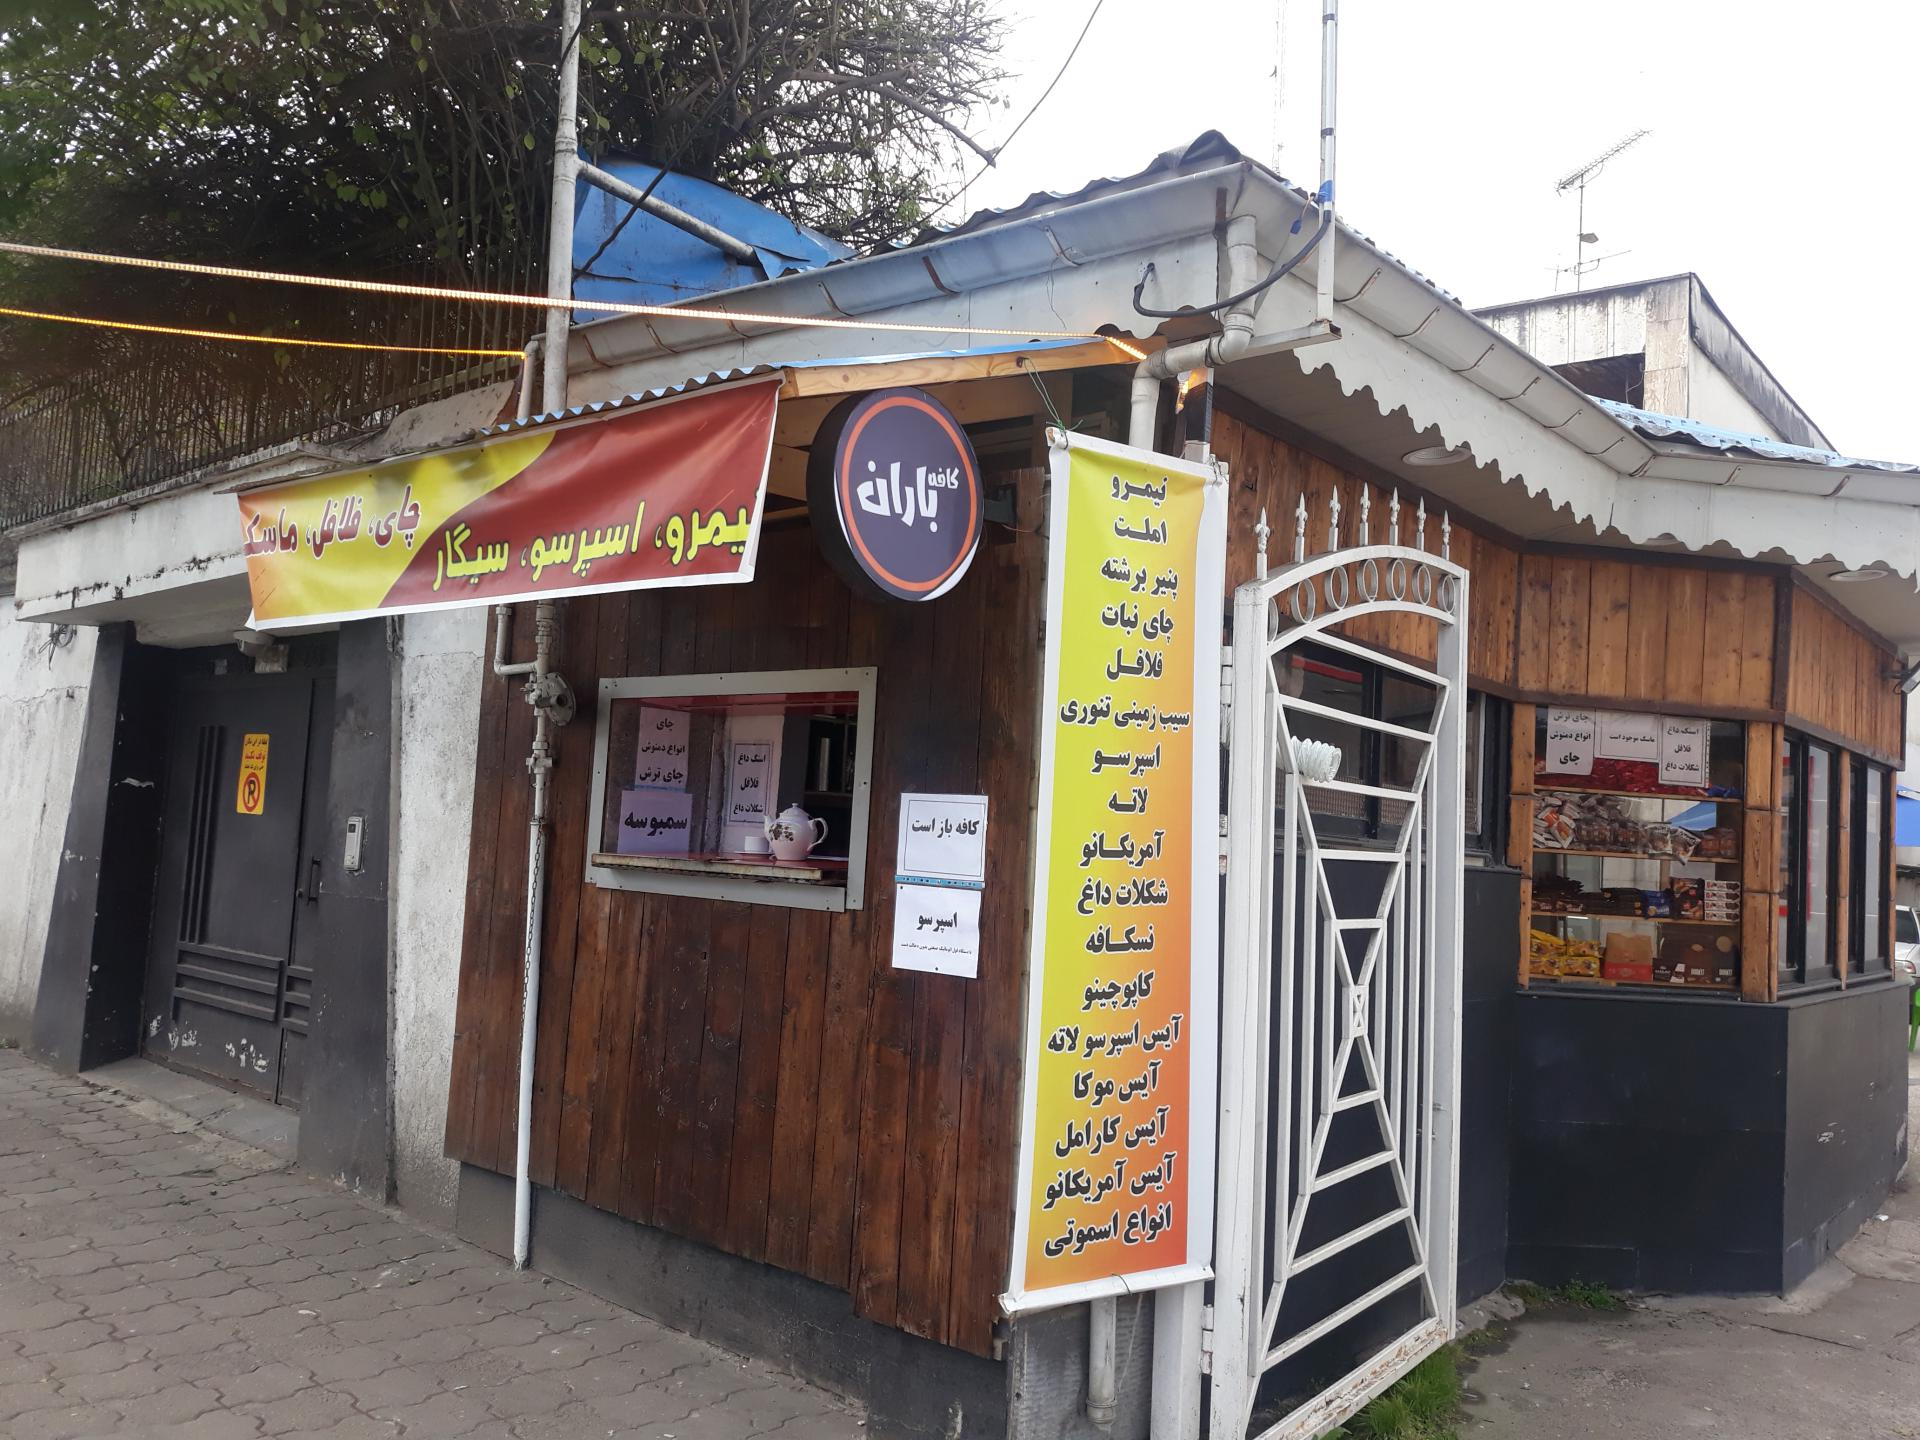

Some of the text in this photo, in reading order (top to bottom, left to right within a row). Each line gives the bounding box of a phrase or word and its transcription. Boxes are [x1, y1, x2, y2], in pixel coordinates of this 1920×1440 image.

[856, 459, 939, 533] باران
[927, 466, 960, 490] کافه
[1111, 474, 1168, 507] نیمرو
[305, 496, 363, 560] فلافل،
[368, 485, 421, 549] چای،
[1113, 516, 1168, 545] املت
[432, 498, 752, 592] یمرو، اسپرسو، سیگار
[1100, 557, 1179, 600] پنیر برشته
[1101, 602, 1175, 643] چای نبات
[1106, 647, 1163, 680] فلافل
[1060, 696, 1190, 732] سیب زمینی تنوری
[1575, 732, 1592, 742] انواع
[1091, 743, 1161, 777] اسپرسو
[1108, 787, 1148, 814] لاته
[624, 811, 689, 837] سمبوسه
[911, 817, 980, 839] کافه باز است
[1079, 831, 1165, 867] آمریکانو
[1077, 877, 1168, 914] شکلات داغ
[916, 911, 958, 934] اسپرسو
[1085, 925, 1155, 953] نسکافه
[1081, 971, 1154, 1011] کاپوچینو
[1047, 1014, 1184, 1058] آیس اسپرسو لاته
[1073, 1060, 1161, 1106] آیس موکا
[1054, 1106, 1169, 1157] آیس کارامل
[1042, 1153, 1176, 1209] آیس آمریکانو
[1044, 1203, 1173, 1257] انواع اسموتی
